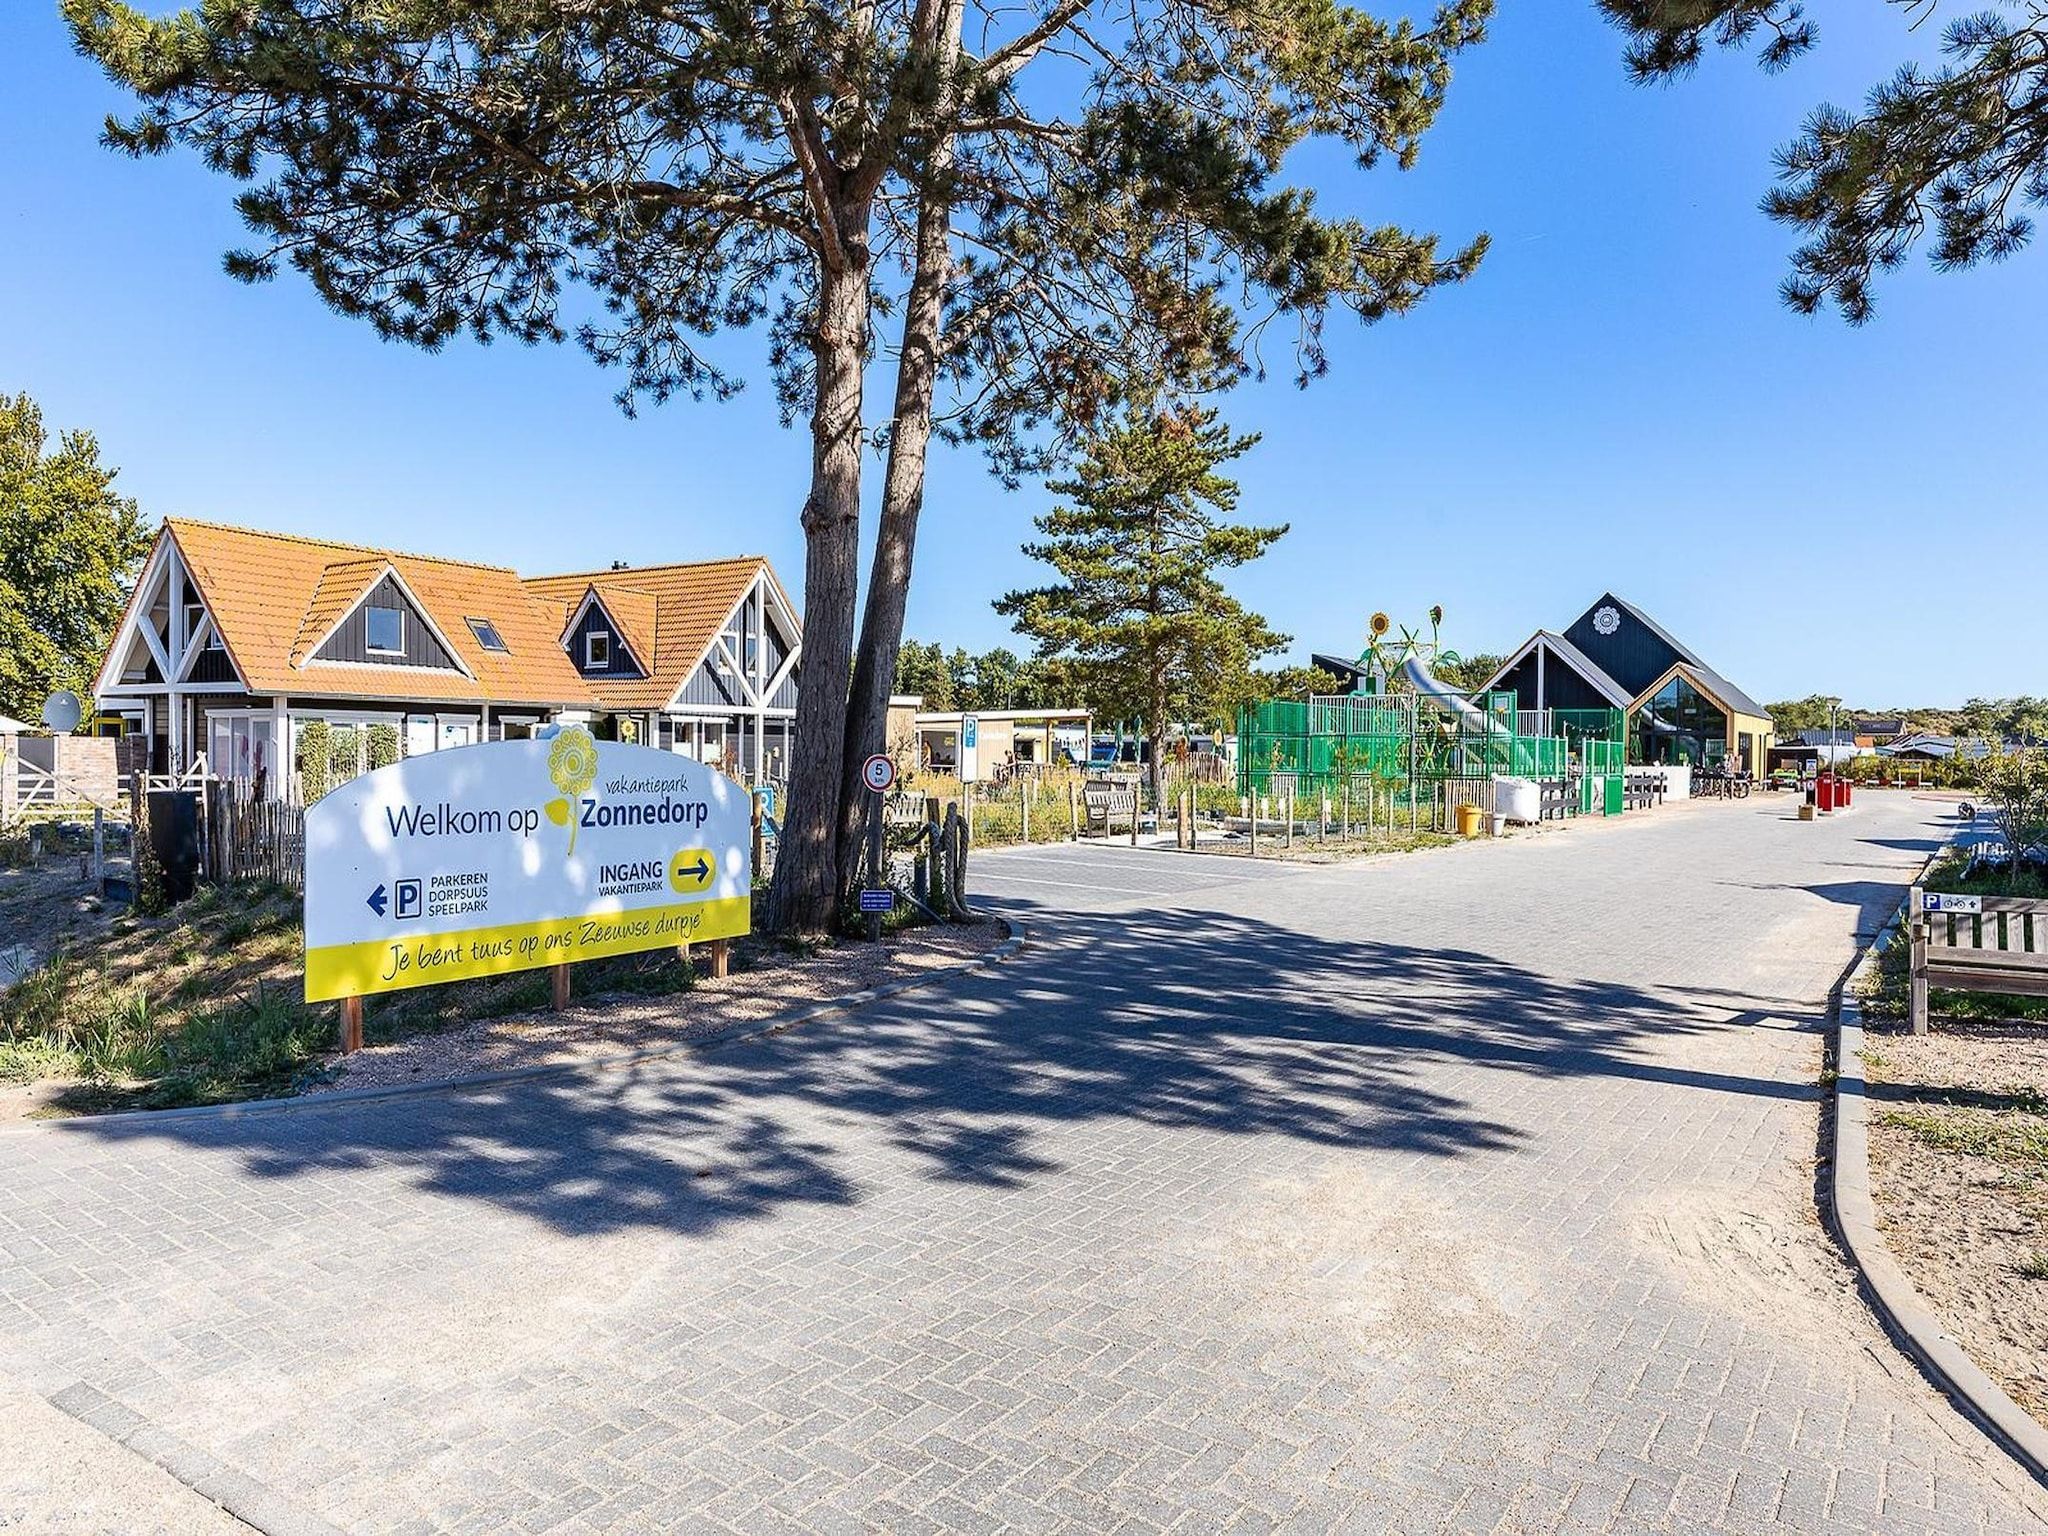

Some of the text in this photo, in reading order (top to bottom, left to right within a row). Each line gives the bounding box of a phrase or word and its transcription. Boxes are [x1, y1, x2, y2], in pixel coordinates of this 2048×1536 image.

[875, 763, 883, 776] 5
[605, 774, 689, 799] vakantiepark
[386, 803, 539, 838] Welkom op
[581, 796, 708, 829] Zonnedorp
[431, 873, 488, 888] PARKEREN
[600, 861, 663, 884] INGANG
[399, 884, 418, 914] P
[429, 886, 488, 903] DORPSUUS
[598, 881, 663, 897] VAKANTIEPARK
[428, 900, 488, 917] SPEELPARK
[1926, 895, 1938, 909] P
[382, 944, 411, 981] Je
[417, 943, 463, 969] bent
[470, 939, 512, 960] tuus
[519, 936, 539, 961] op
[544, 931, 572, 950] ons
